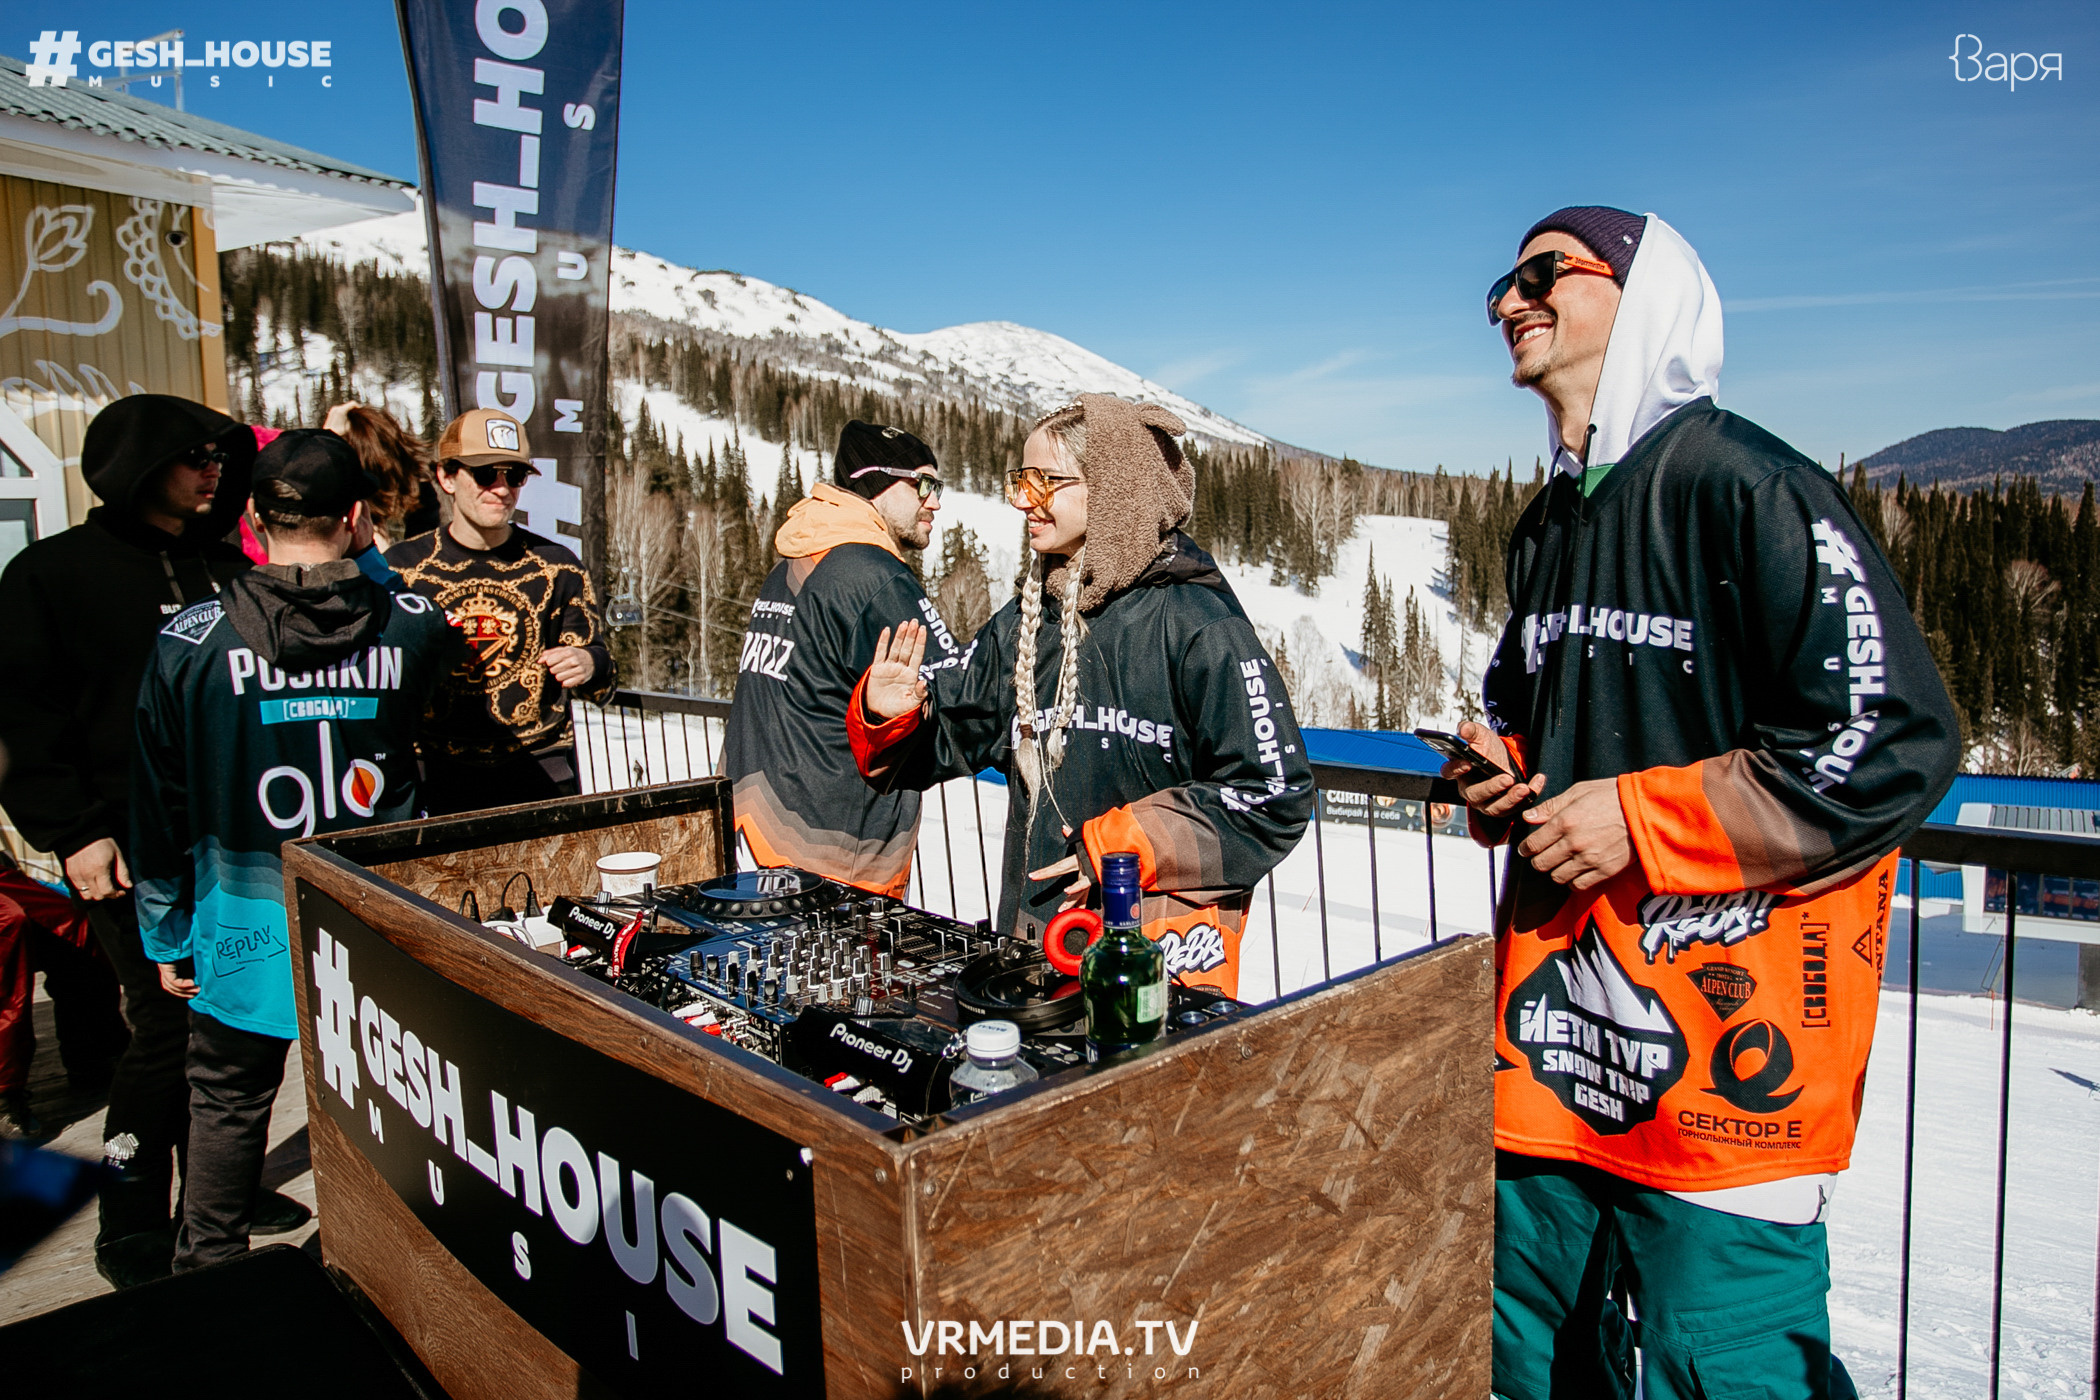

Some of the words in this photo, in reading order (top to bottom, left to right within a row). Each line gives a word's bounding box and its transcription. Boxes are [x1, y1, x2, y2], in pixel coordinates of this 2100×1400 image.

[257, 720, 385, 838] glo
[568, 905, 605, 932] Pioneer
[215, 924, 270, 960] REPLAY
[1700, 975, 1727, 996] ALPEN
[1728, 981, 1752, 999] CLUB
[829, 1022, 892, 1061] Pioneer
[1542, 1049, 1602, 1086] SNOW
[1605, 1067, 1650, 1105] TRIP
[1574, 1082, 1625, 1123] GESH
[1677, 1110, 1780, 1138] СЕКТОР
[1677, 1127, 1753, 1148] ГОРНОЛЫЖНЫЙ
[1754, 1141, 1802, 1150] КОМПЛЕКС
[312, 927, 784, 1376] #GESH_HOUSE
